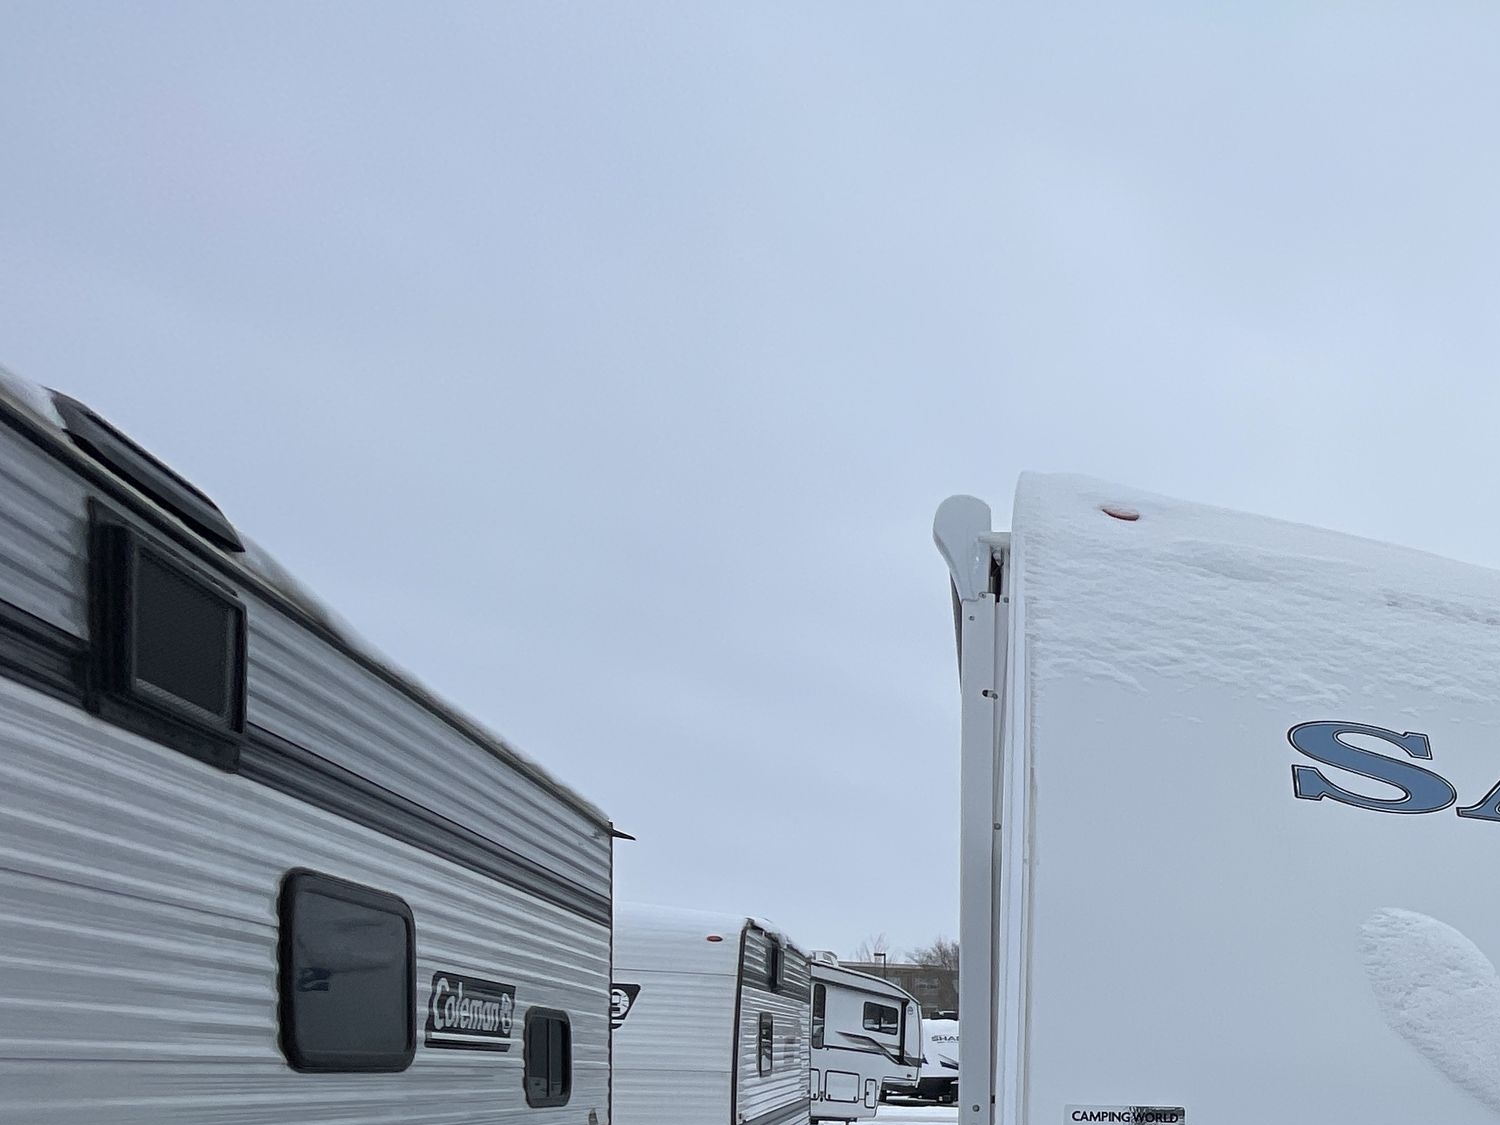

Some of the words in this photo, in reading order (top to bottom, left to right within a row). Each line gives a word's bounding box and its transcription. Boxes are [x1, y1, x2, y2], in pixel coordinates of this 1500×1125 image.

[433, 977, 500, 1032] Coleman
[1071, 1111, 1131, 1123] CAMPING
[1133, 1111, 1179, 1123] WORLD
